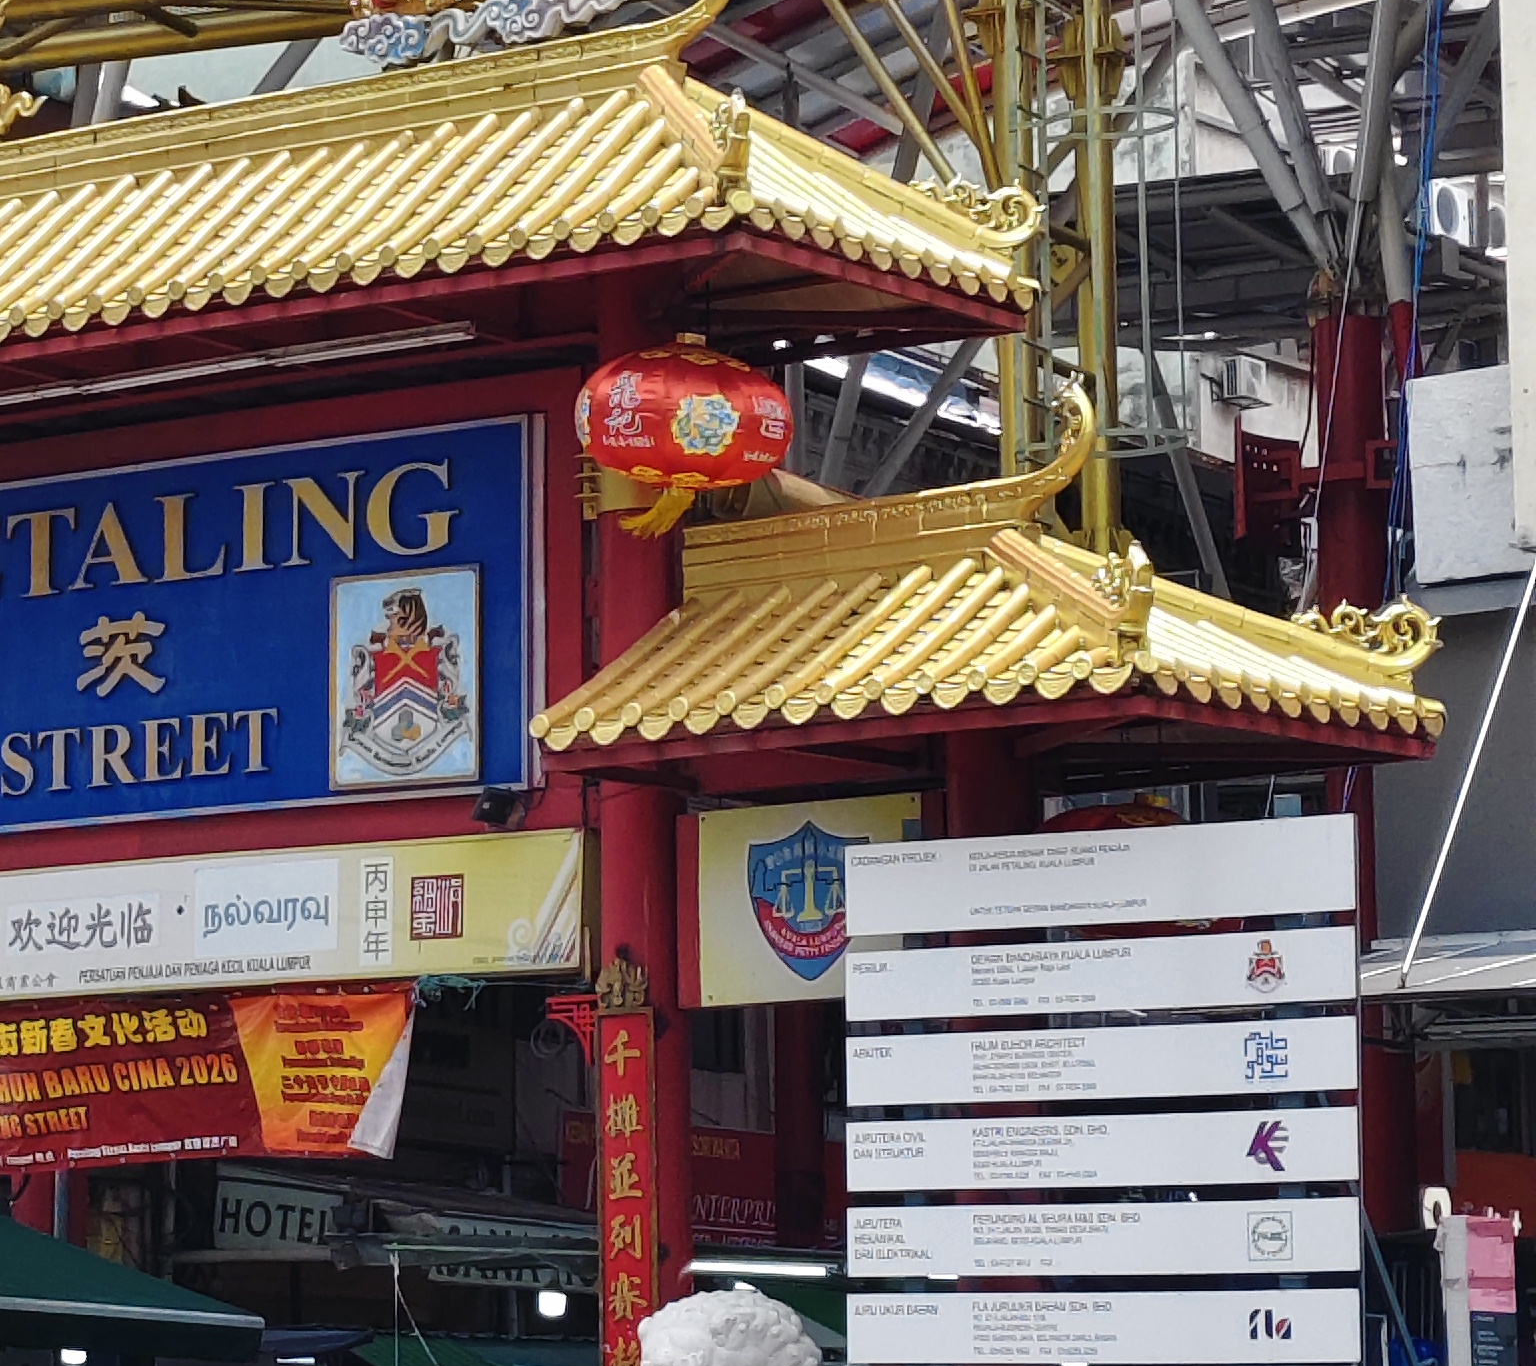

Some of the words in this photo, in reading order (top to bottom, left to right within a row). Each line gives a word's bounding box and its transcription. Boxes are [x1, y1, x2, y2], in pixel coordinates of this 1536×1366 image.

[1, 707, 279, 796] STREET
[8, 901, 153, 952] 欢迎光临
[364, 862, 389, 961] 丙申年
[42, 1062, 111, 1099] BARU
[114, 1055, 175, 1092] CINA
[176, 1053, 238, 1086] 2026
[25, 1106, 88, 1135] STREET
[218, 1197, 335, 1245] HOTEL
